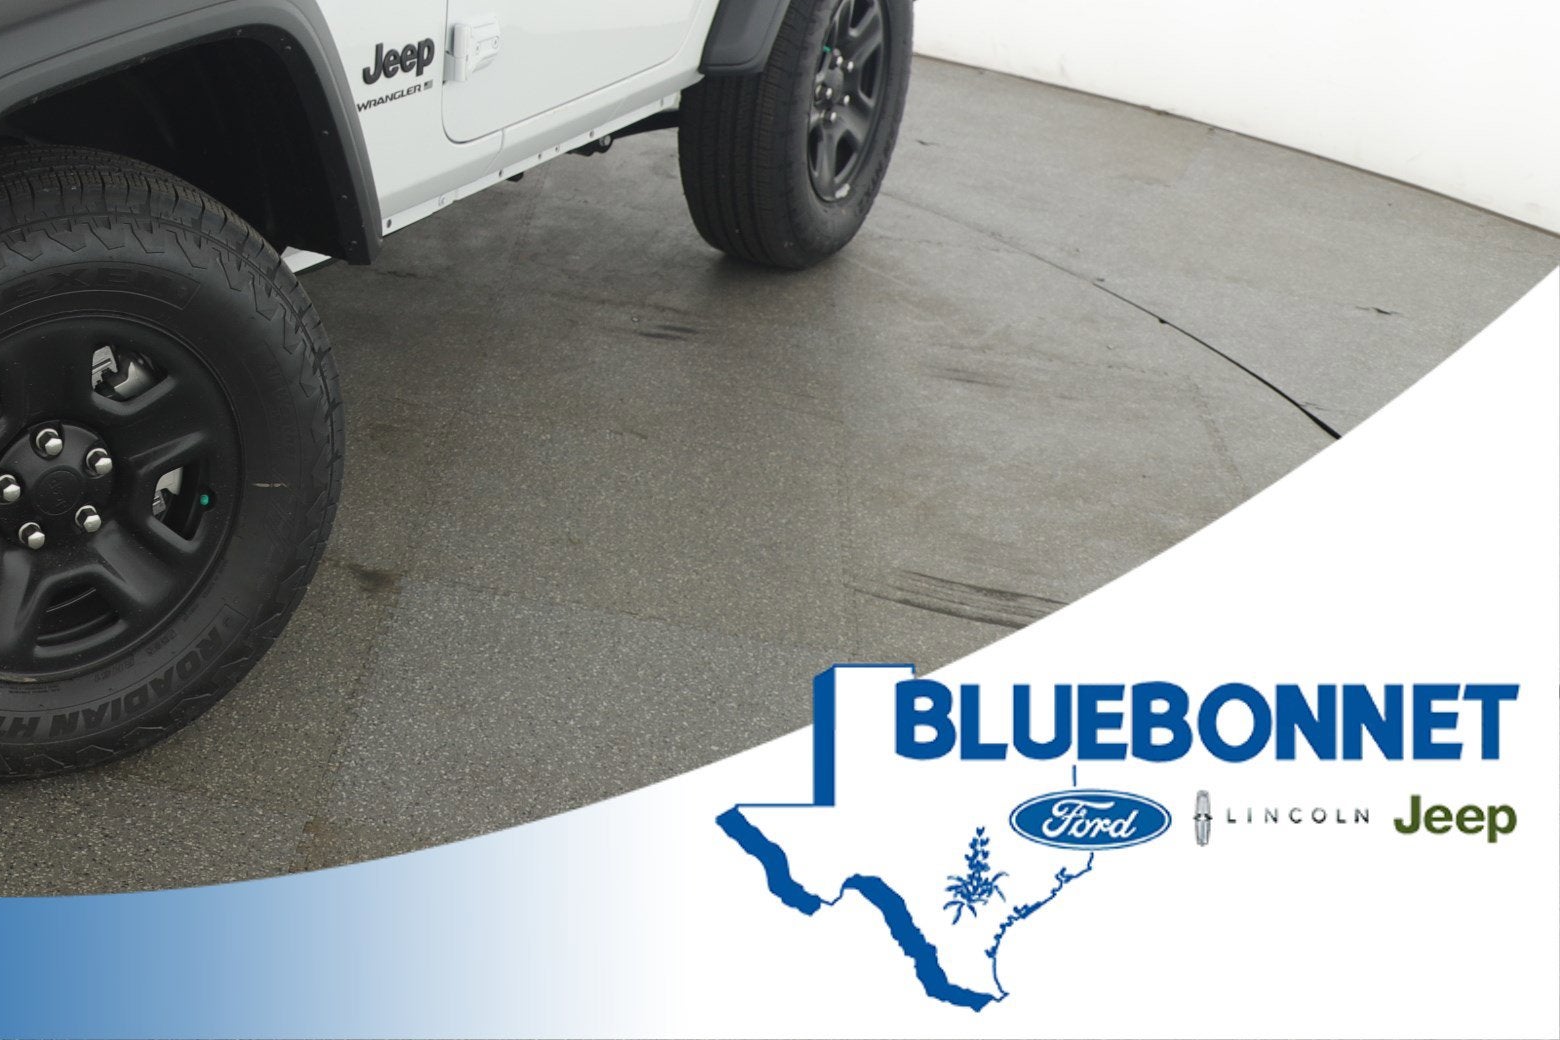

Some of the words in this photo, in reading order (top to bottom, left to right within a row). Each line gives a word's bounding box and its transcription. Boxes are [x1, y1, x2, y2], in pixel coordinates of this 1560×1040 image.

[362, 37, 435, 85] Jeep
[356, 84, 422, 112] WRANGLER
[50, 626, 224, 735] ROADIAN
